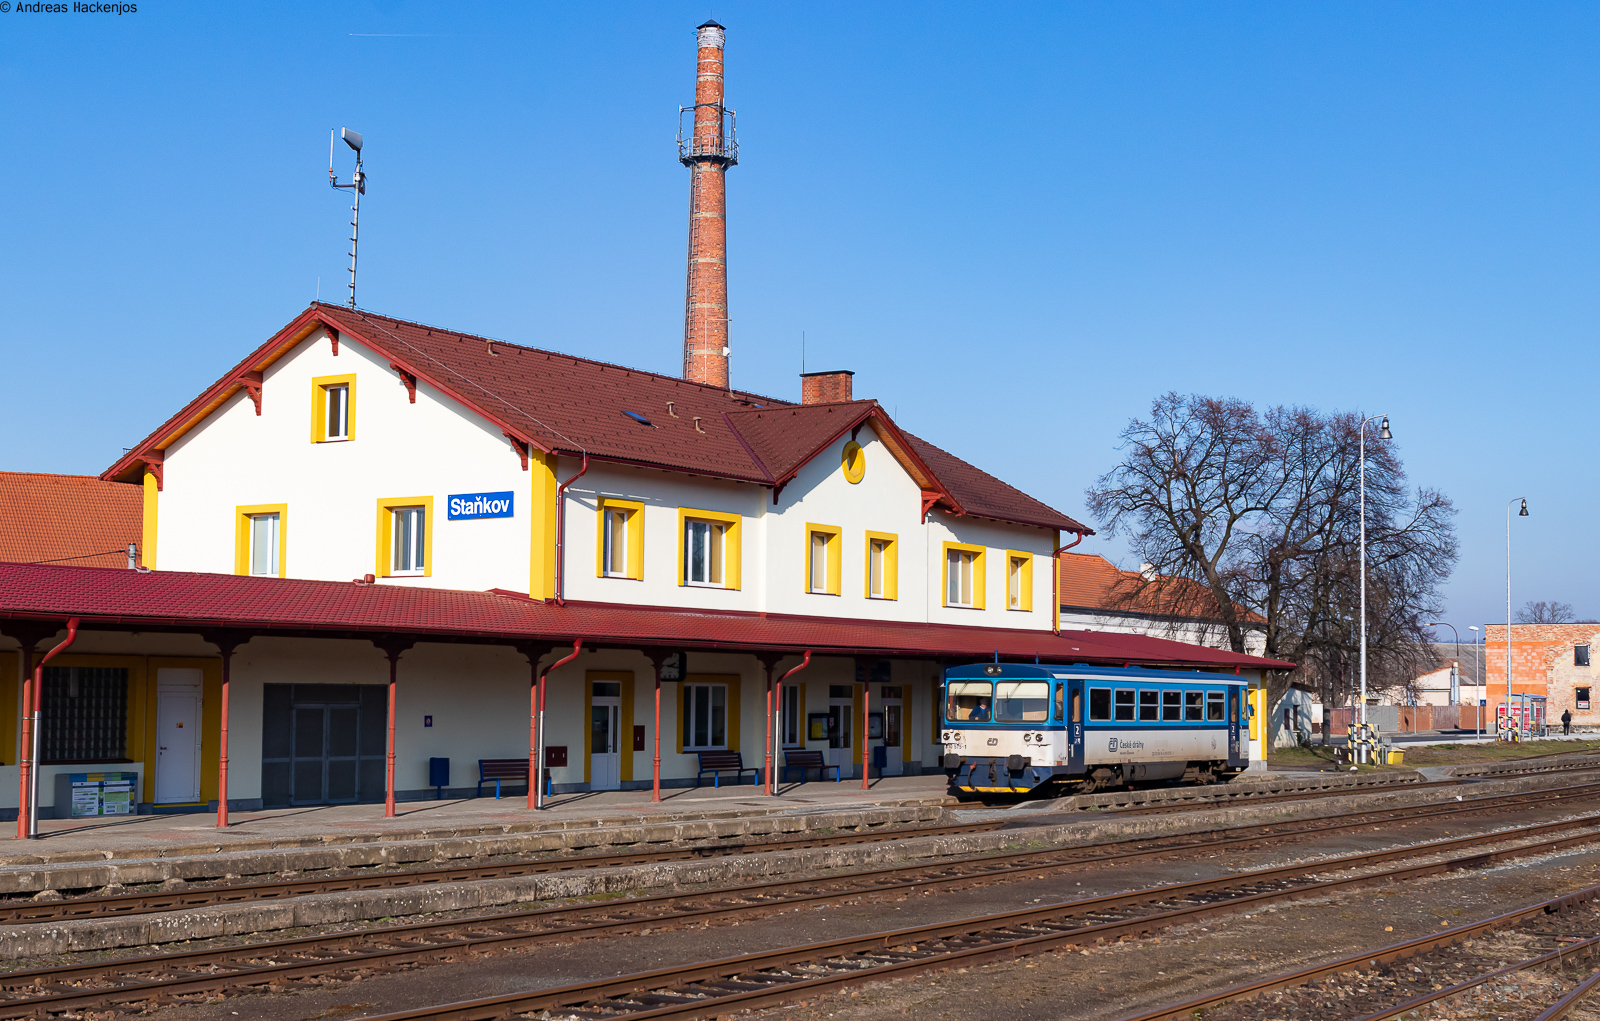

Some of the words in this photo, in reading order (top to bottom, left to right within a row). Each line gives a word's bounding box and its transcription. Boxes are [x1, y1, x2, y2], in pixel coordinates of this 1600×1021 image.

[450, 496, 510, 516] Staňkov
[1075, 725, 1080, 735] 2
[1119, 739, 1132, 749] České
[1132, 740, 1144, 750] dráhy
